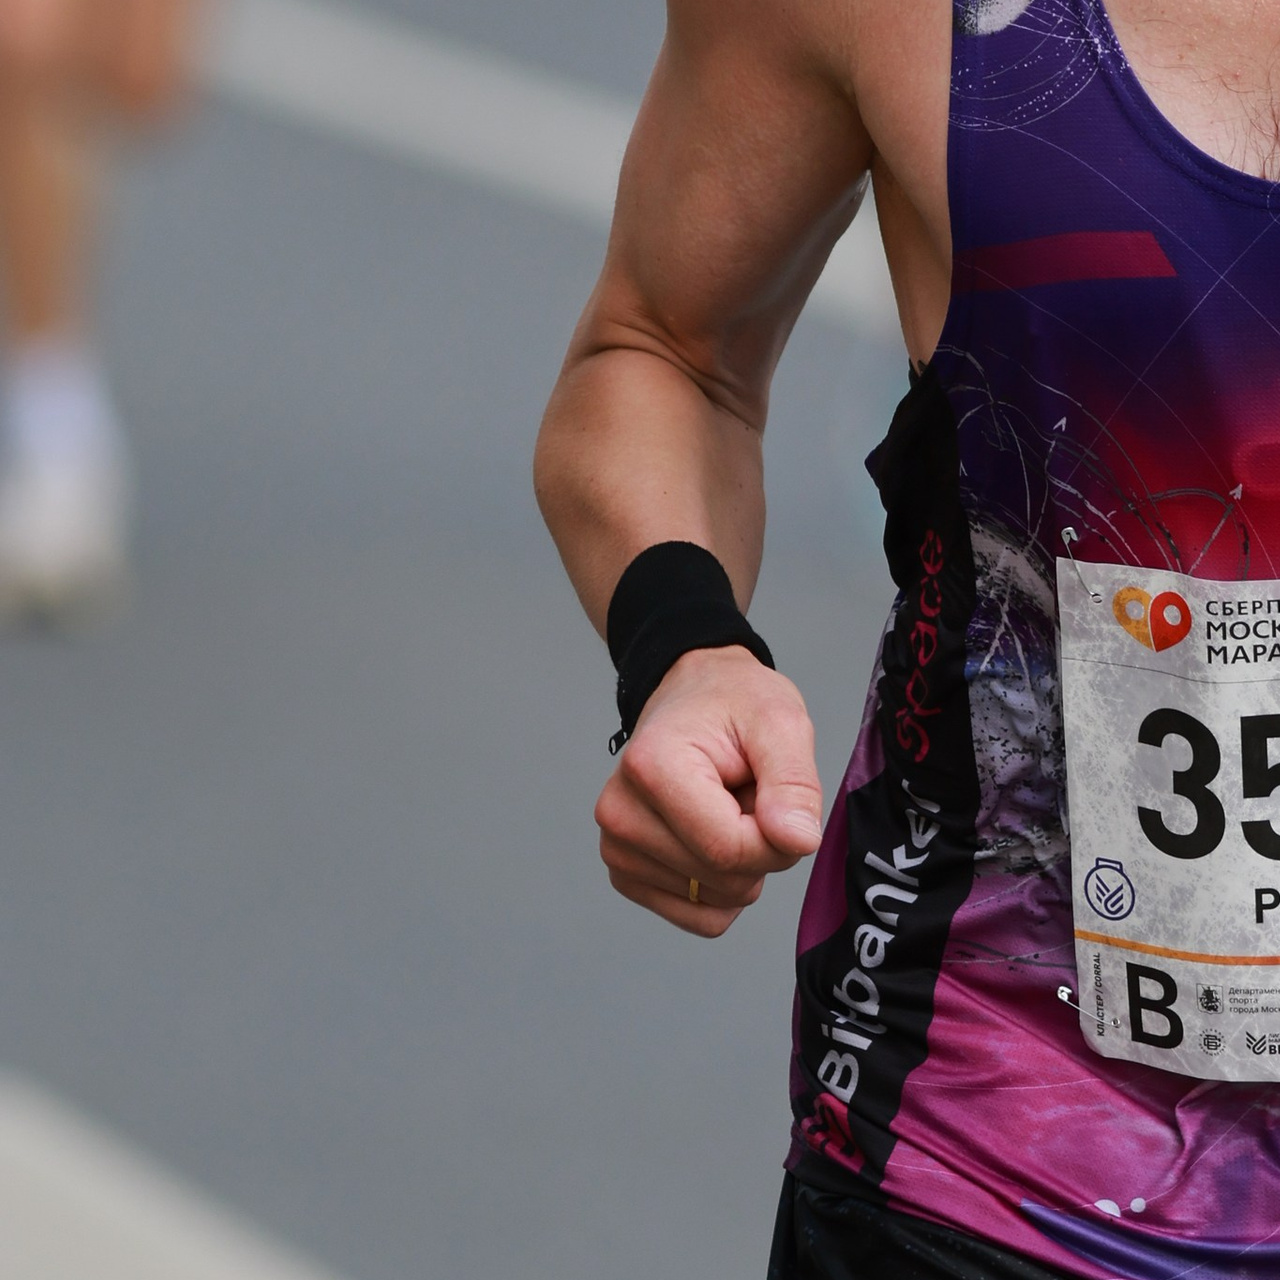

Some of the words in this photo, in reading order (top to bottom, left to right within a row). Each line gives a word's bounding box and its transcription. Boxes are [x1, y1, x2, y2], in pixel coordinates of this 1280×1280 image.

[817, 778, 941, 1104] Bitbanker
[1092, 952, 1103, 988] CORRAL
[1229, 1006, 1259, 1014] города
